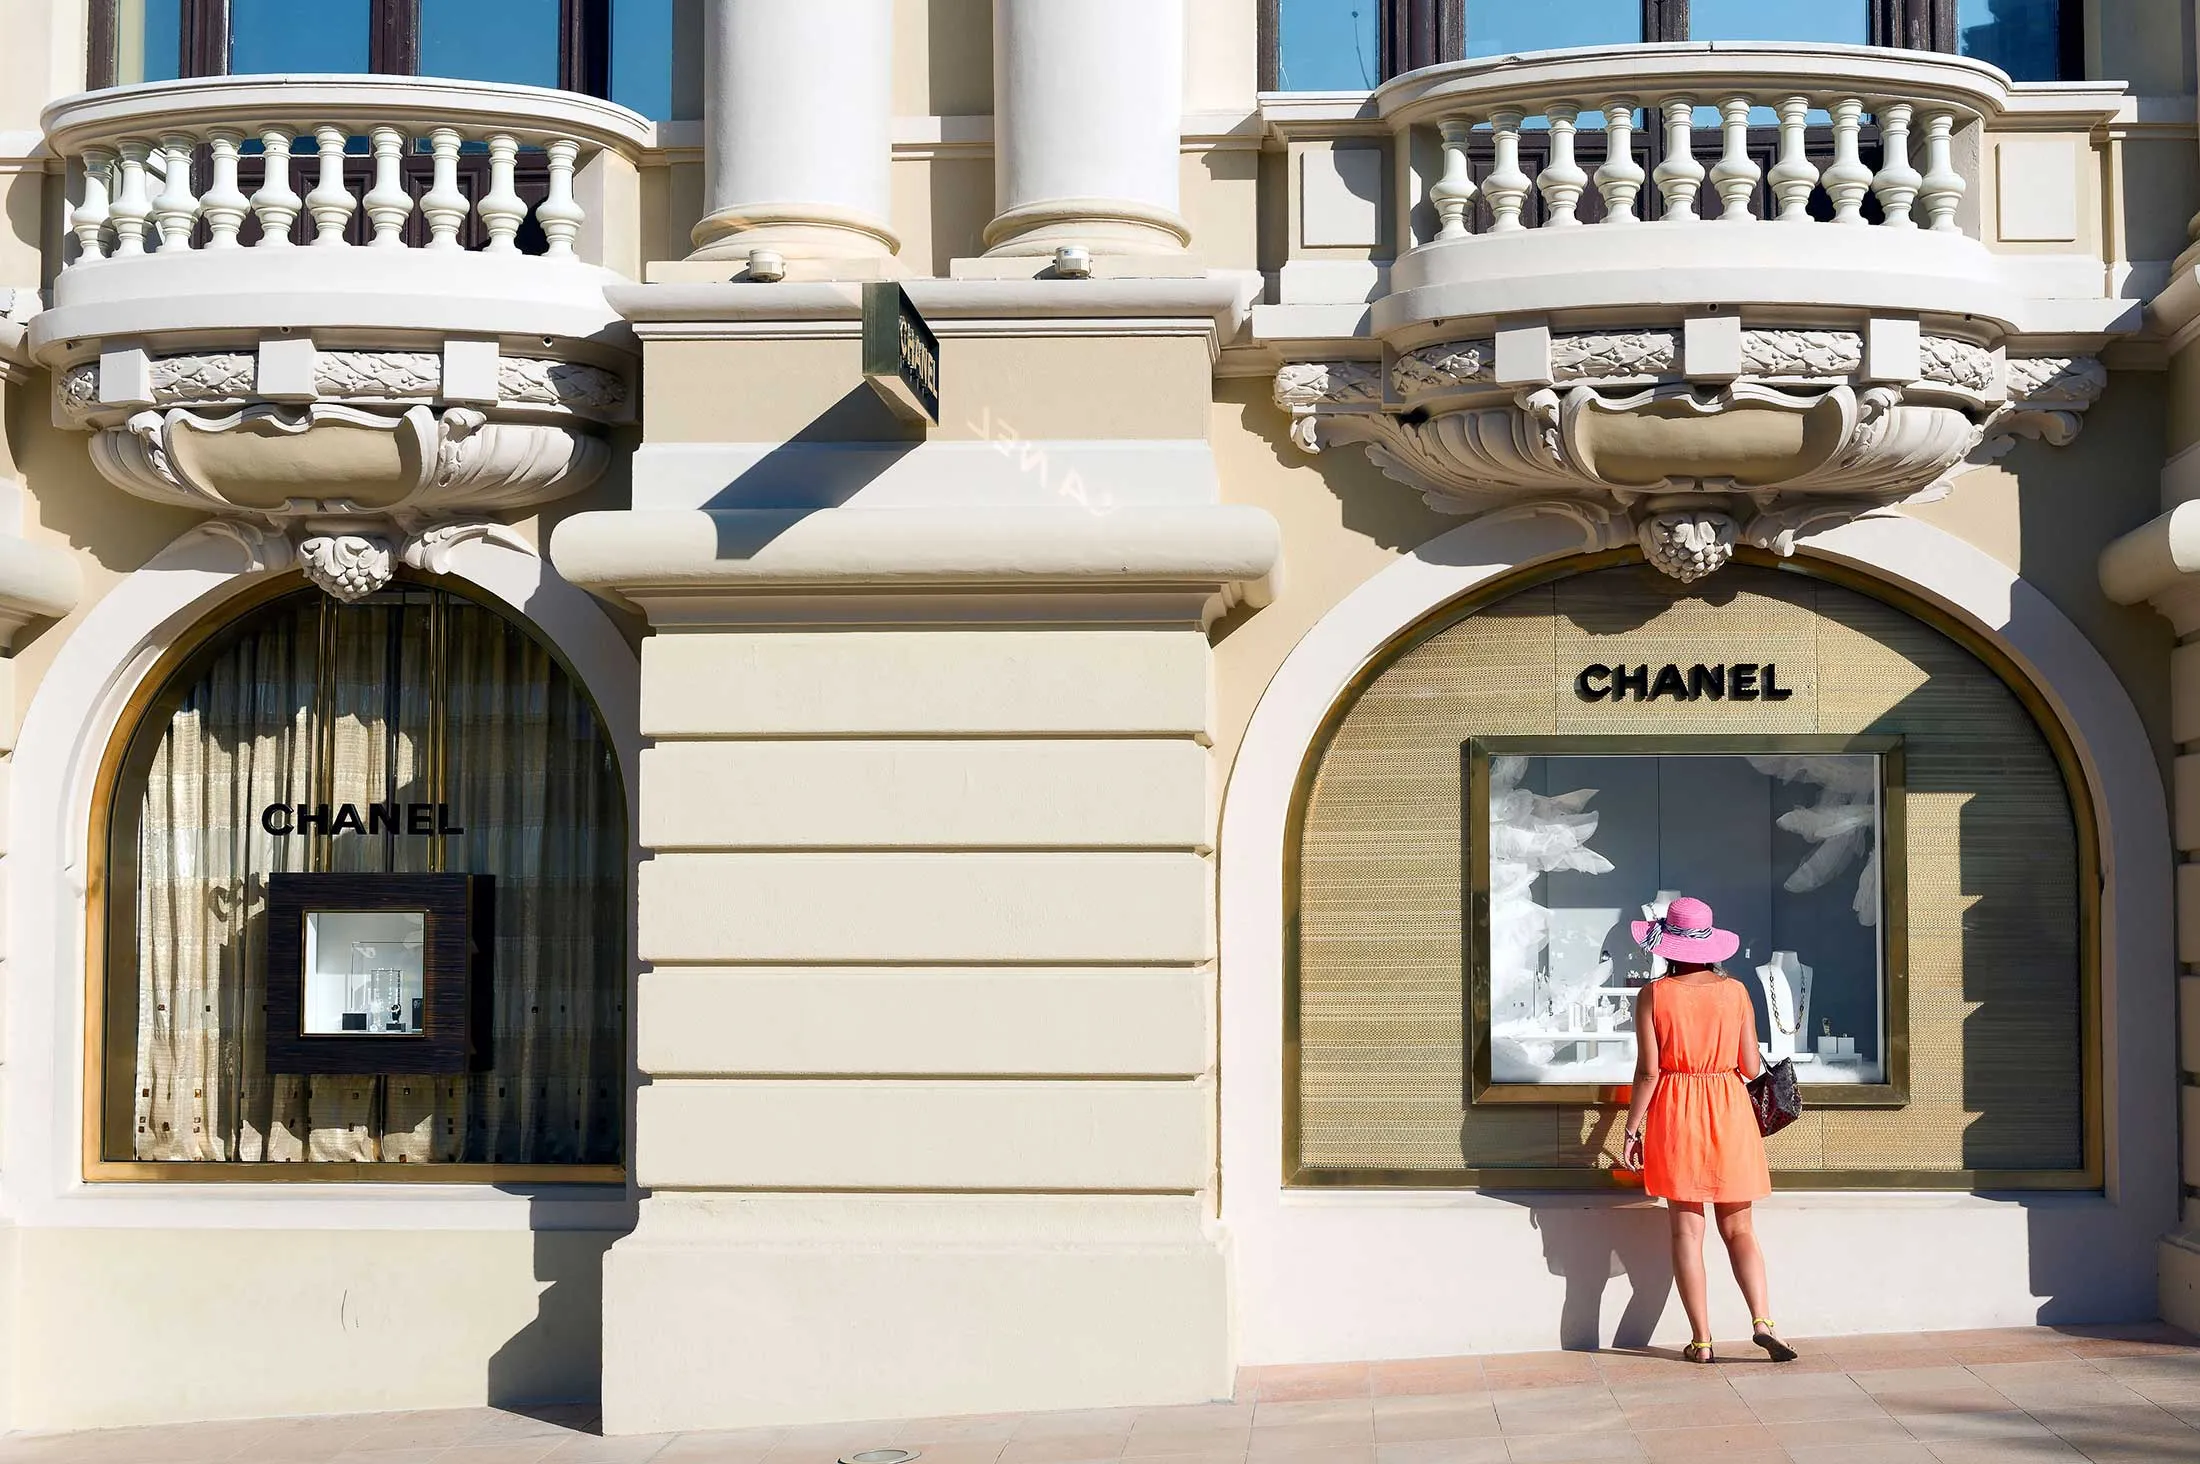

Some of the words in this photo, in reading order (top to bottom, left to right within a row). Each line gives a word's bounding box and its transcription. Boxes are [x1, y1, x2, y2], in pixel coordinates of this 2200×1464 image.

[899, 316, 938, 399] CHANEL
[1574, 663, 1792, 702] CHANEL
[261, 803, 464, 836] CHANEL
